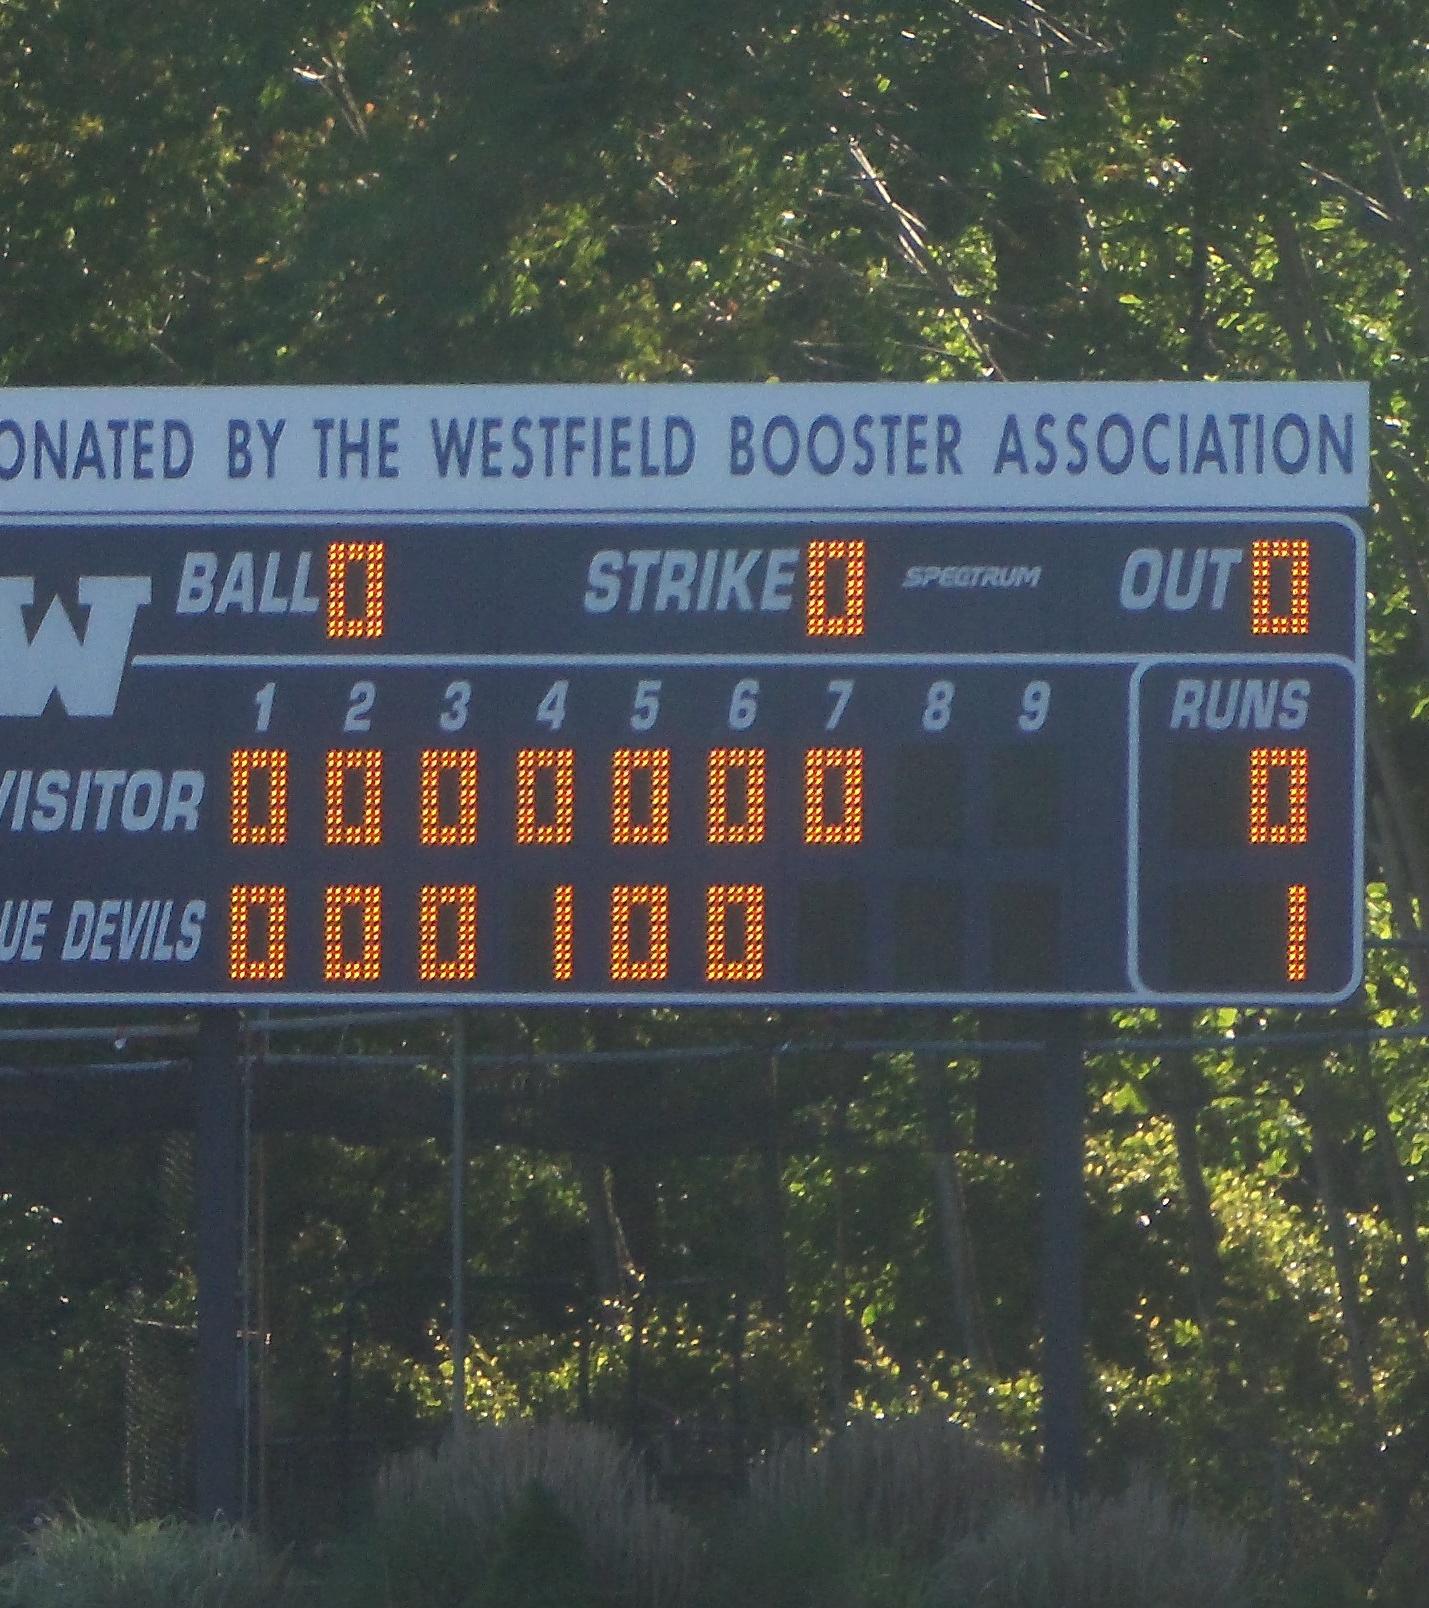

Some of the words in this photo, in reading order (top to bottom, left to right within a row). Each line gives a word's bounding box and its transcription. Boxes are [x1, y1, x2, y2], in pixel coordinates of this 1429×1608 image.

[227, 417, 286, 478] BY
[312, 416, 400, 479] THE
[430, 414, 696, 479] WESTFIELD
[729, 414, 964, 476] BOOSTER
[993, 412, 1355, 476] ASSOCIATION
[175, 550, 321, 615] BALL
[327, 541, 385, 639] 0
[583, 548, 802, 614] STRIKE
[806, 539, 866, 637] 0
[901, 565, 1042, 589] SPECTRUM
[1119, 548, 1243, 613] OUT
[1250, 539, 1310, 636] 0
[252, 680, 277, 731] 1
[343, 680, 377, 731] 2
[439, 680, 473, 731] 3
[537, 680, 569, 731] 4
[630, 680, 665, 731] 5
[727, 680, 759, 731] 6
[823, 680, 853, 731] 7
[921, 680, 955, 731] 8
[1017, 680, 1051, 731] 9
[1169, 678, 1311, 730] RUNS
[230, 747, 288, 845] 0
[324, 747, 384, 845] 0
[419, 747, 478, 845] 0
[516, 747, 574, 845] 0
[611, 747, 670, 845] 0
[707, 747, 766, 845] 0
[804, 747, 864, 845] 0
[1249, 747, 1309, 844] 0
[61, 899, 205, 962] DEVILS
[228, 883, 287, 981] 0
[323, 883, 382, 981] 0
[418, 883, 477, 981] 0
[552, 883, 573, 981] 1
[610, 883, 669, 981] 0
[706, 883, 765, 981] 0
[1285, 882, 1308, 980] 1
